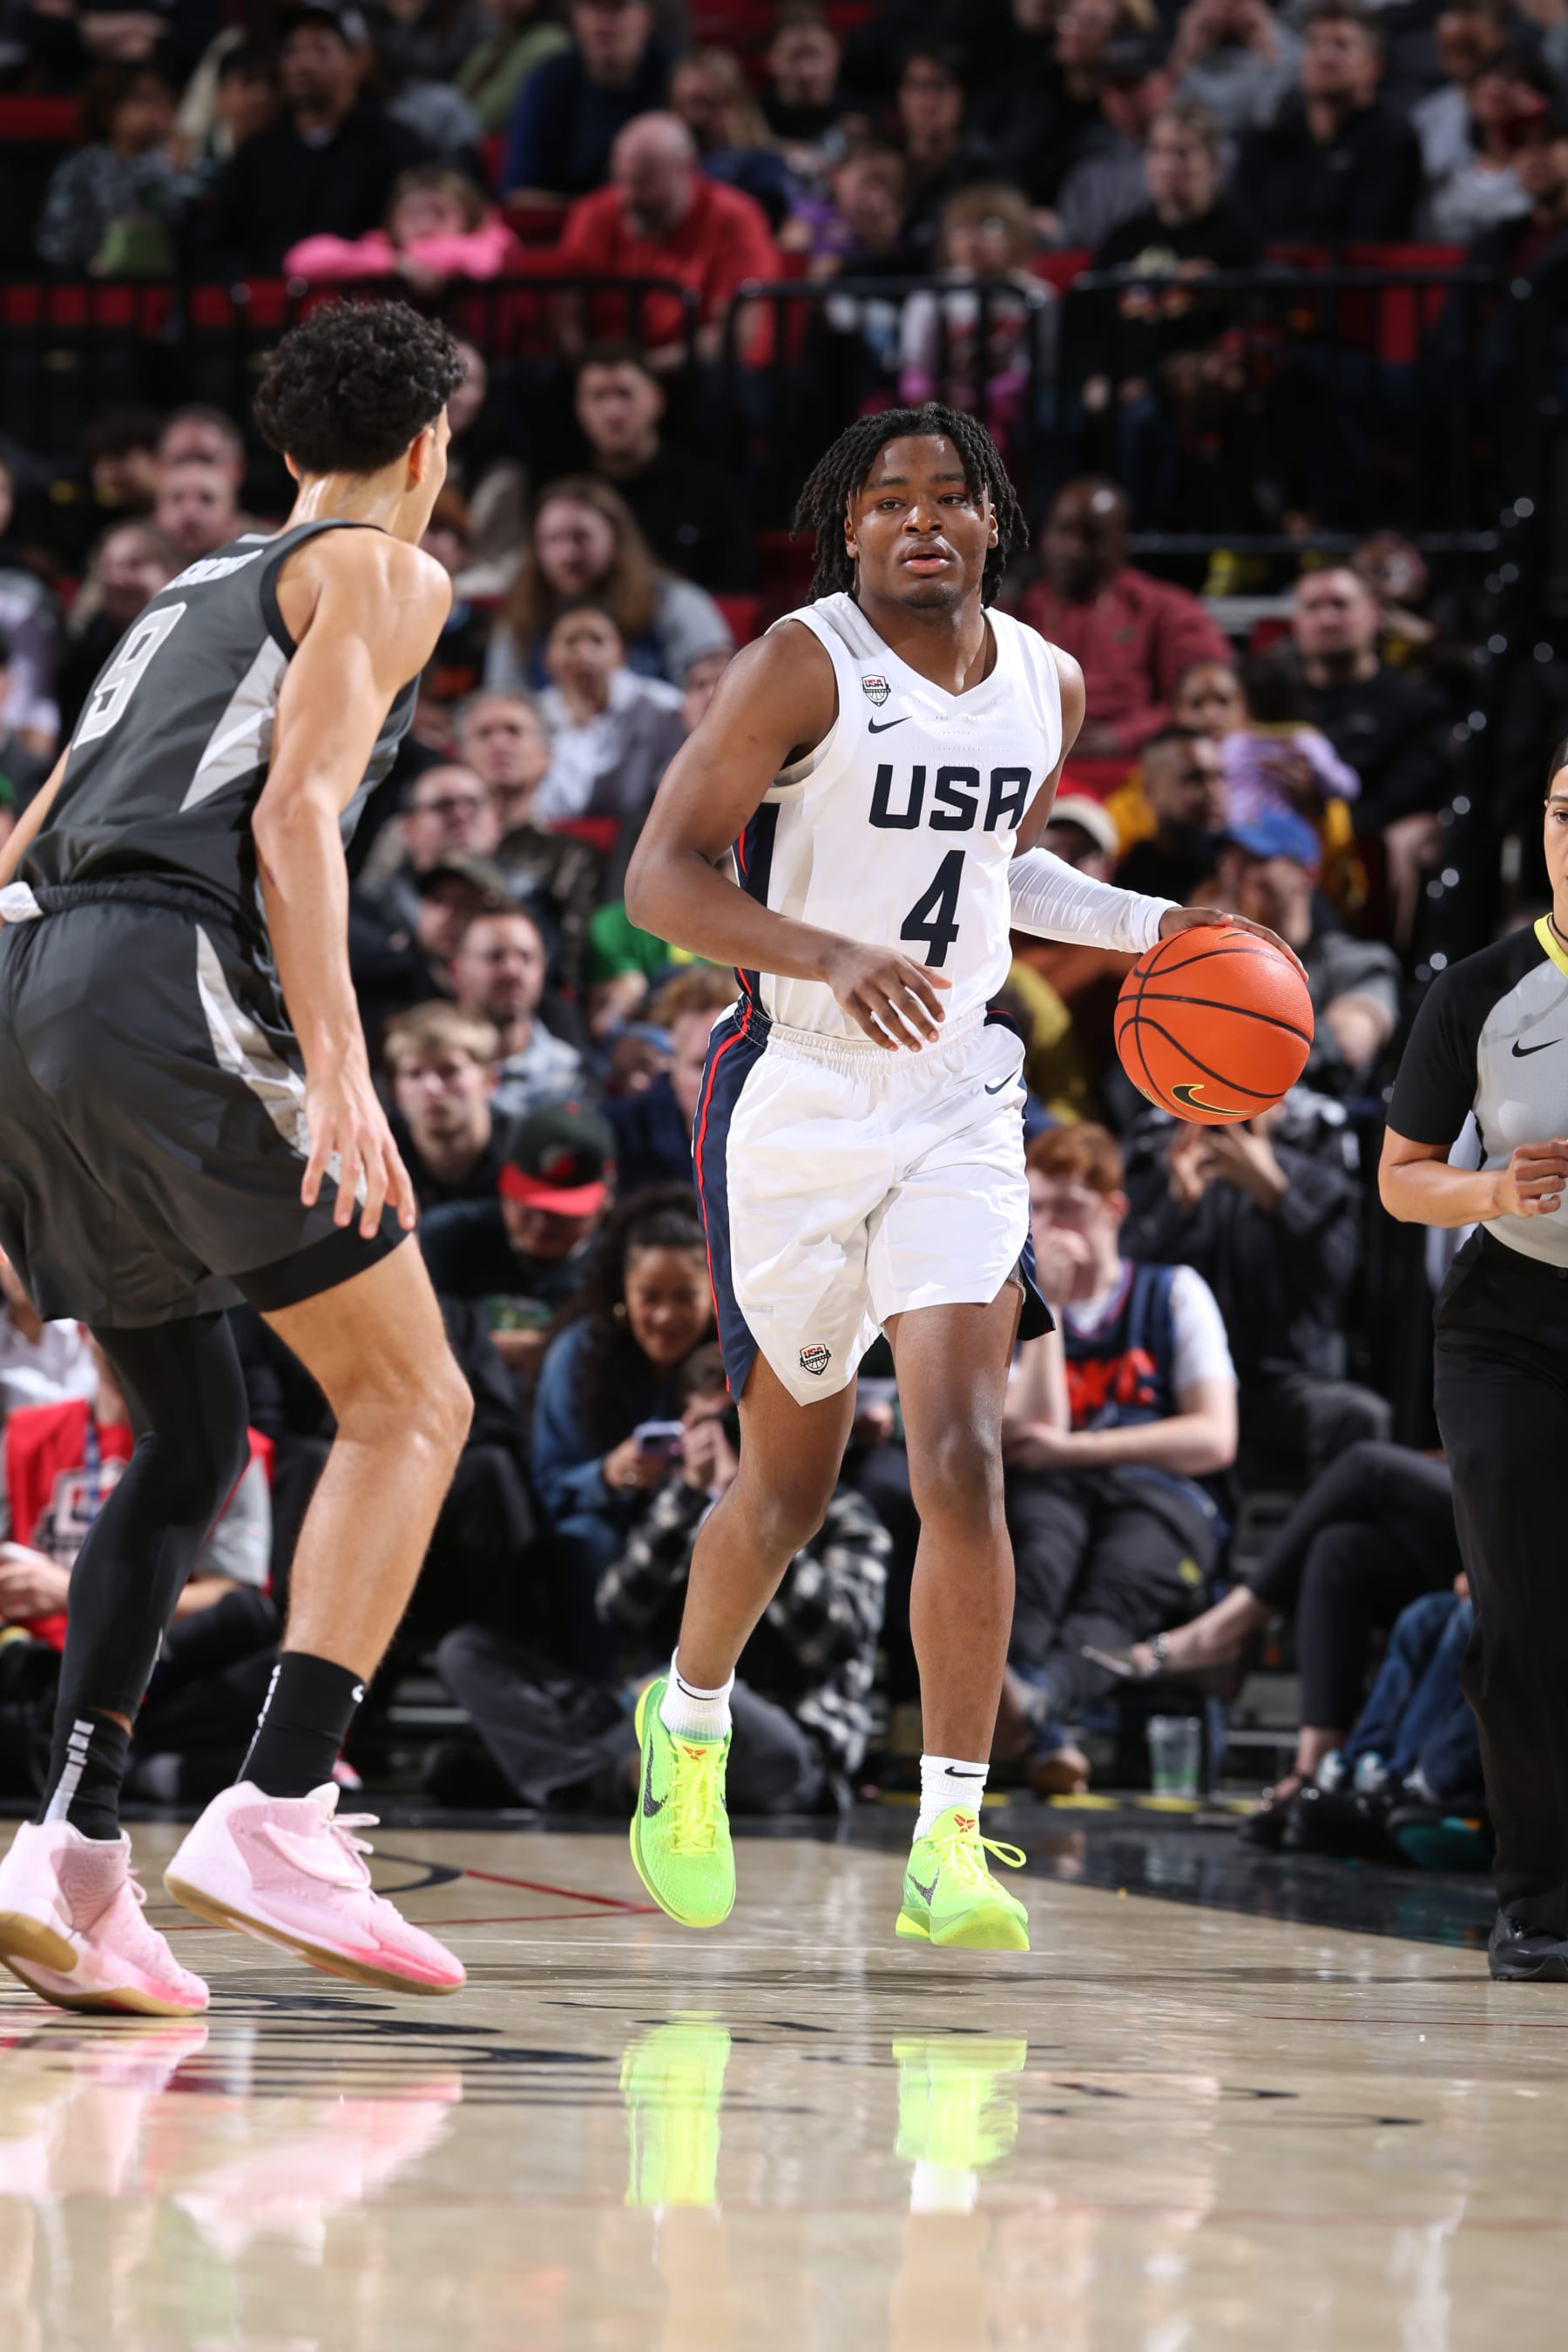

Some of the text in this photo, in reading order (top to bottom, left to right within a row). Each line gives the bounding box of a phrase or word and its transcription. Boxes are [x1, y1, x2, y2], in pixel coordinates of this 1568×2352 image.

[72, 601, 187, 751] 9
[868, 763, 1032, 832] USA
[900, 849, 966, 968] 4
